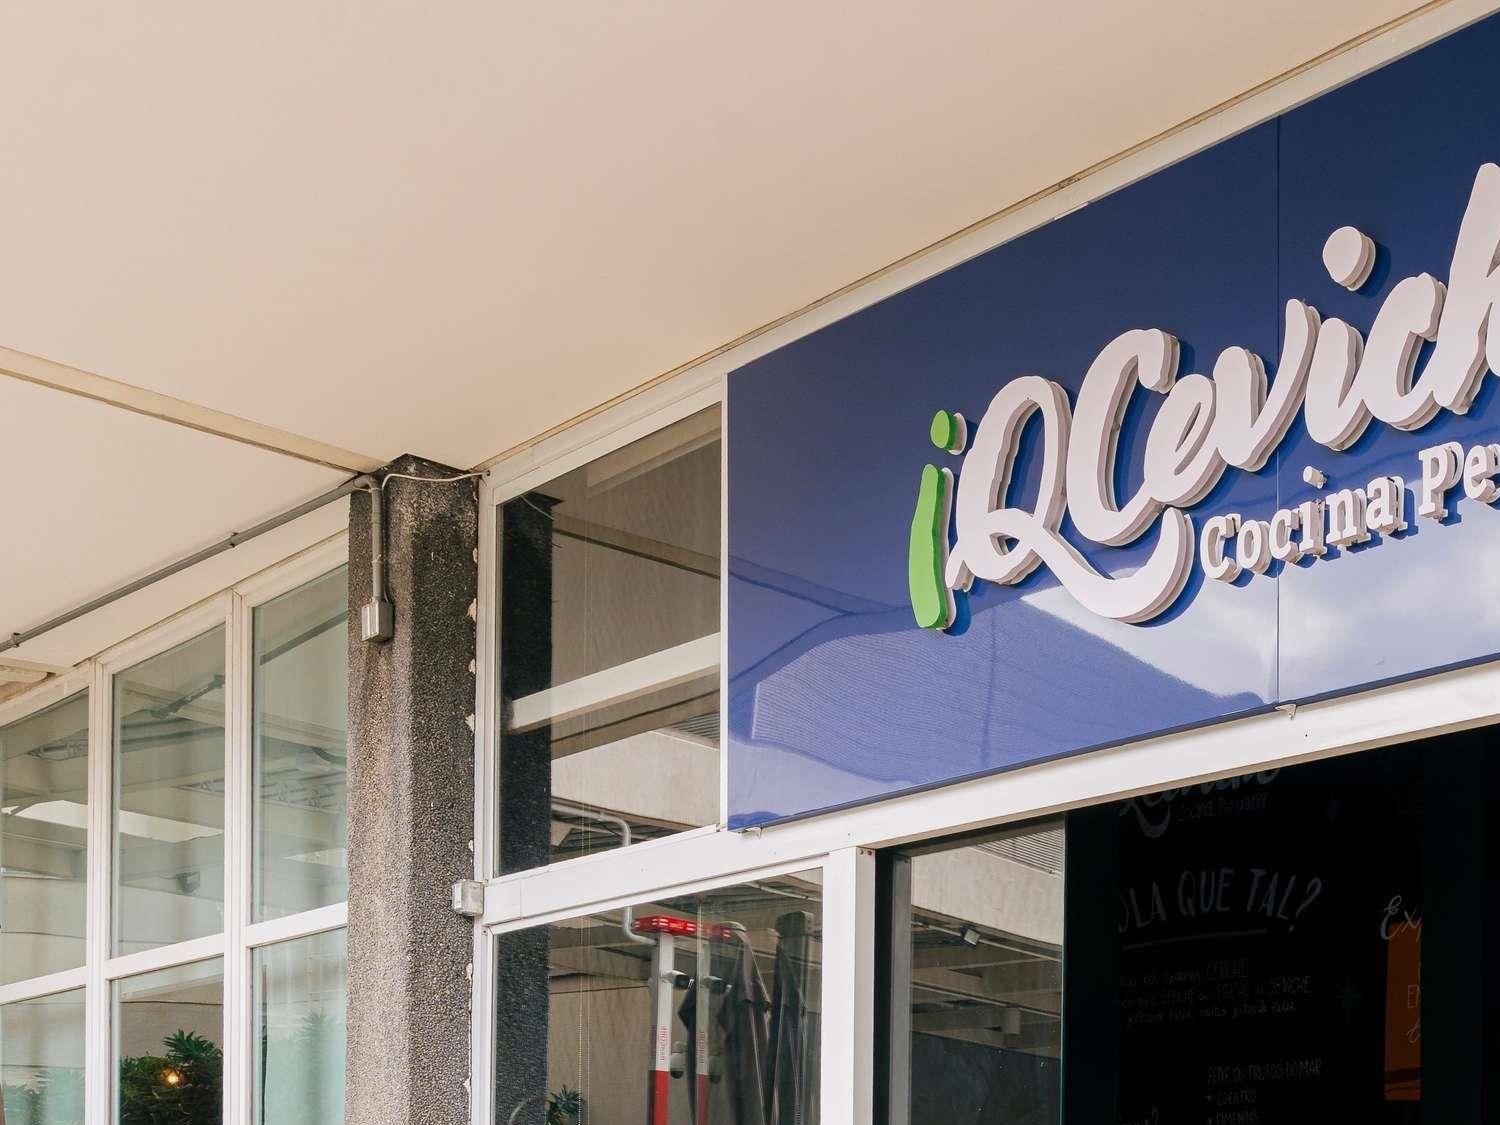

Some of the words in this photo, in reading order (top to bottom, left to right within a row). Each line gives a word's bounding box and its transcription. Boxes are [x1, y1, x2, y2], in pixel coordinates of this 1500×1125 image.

[1200, 466, 1406, 586] Cocina
[1177, 867, 1235, 917] QUE
[1246, 868, 1323, 932] TAL?
